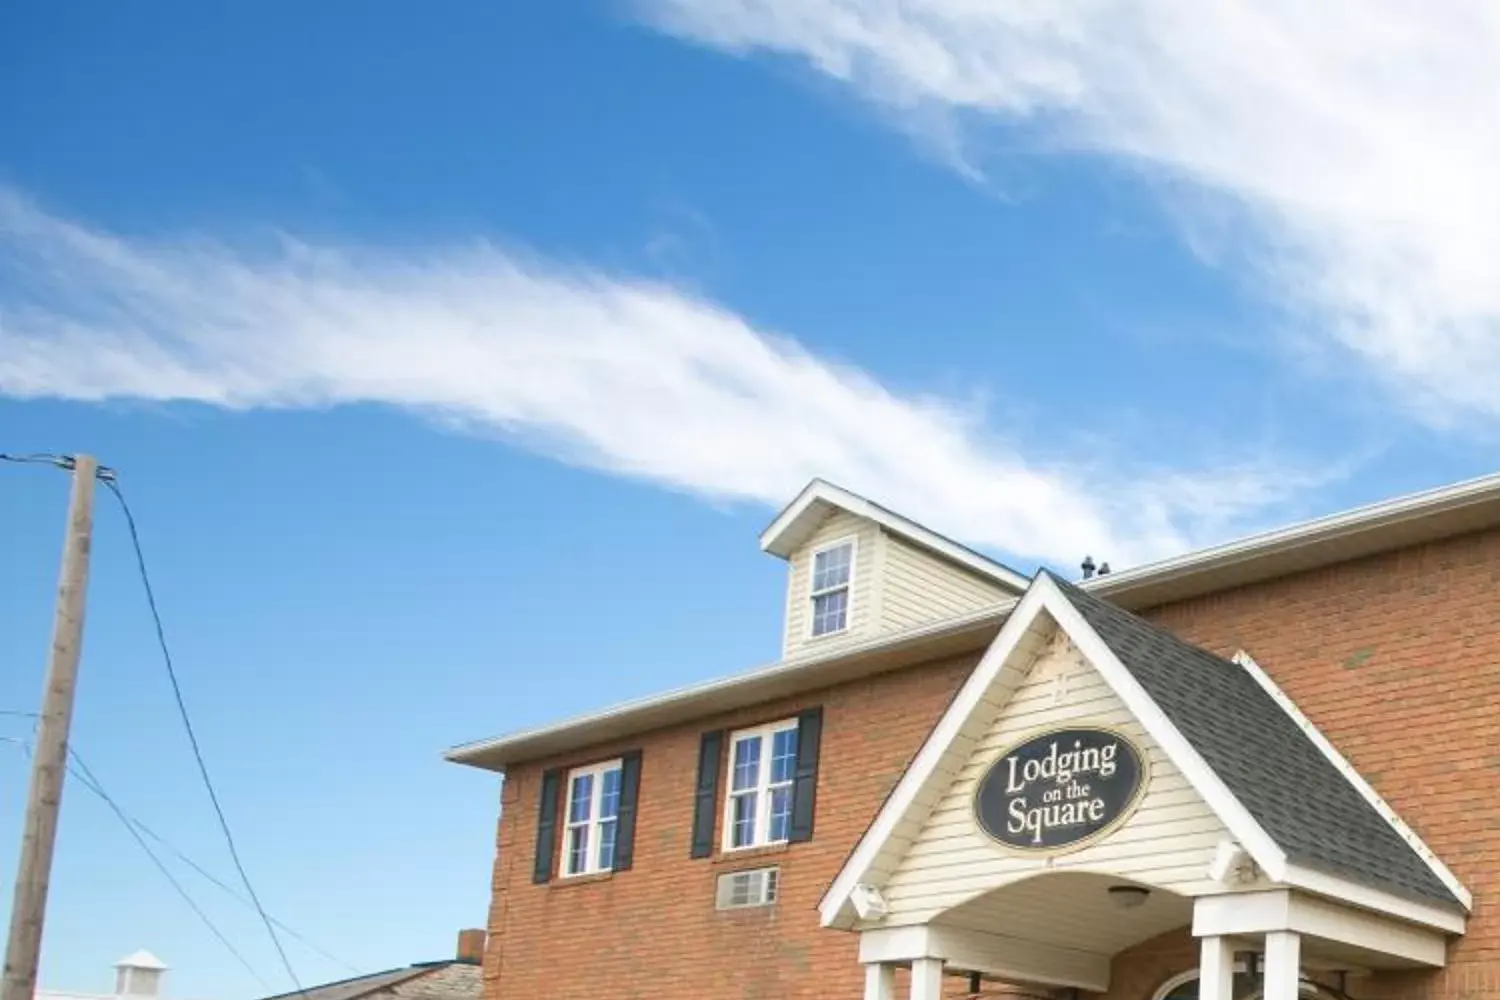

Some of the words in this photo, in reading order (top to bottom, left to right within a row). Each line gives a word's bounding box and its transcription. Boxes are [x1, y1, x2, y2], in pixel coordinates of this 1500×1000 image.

[1006, 740, 1117, 793] Lodging
[1043, 787, 1061, 803] on
[1065, 779, 1091, 800] the
[1007, 797, 1105, 843] Square
